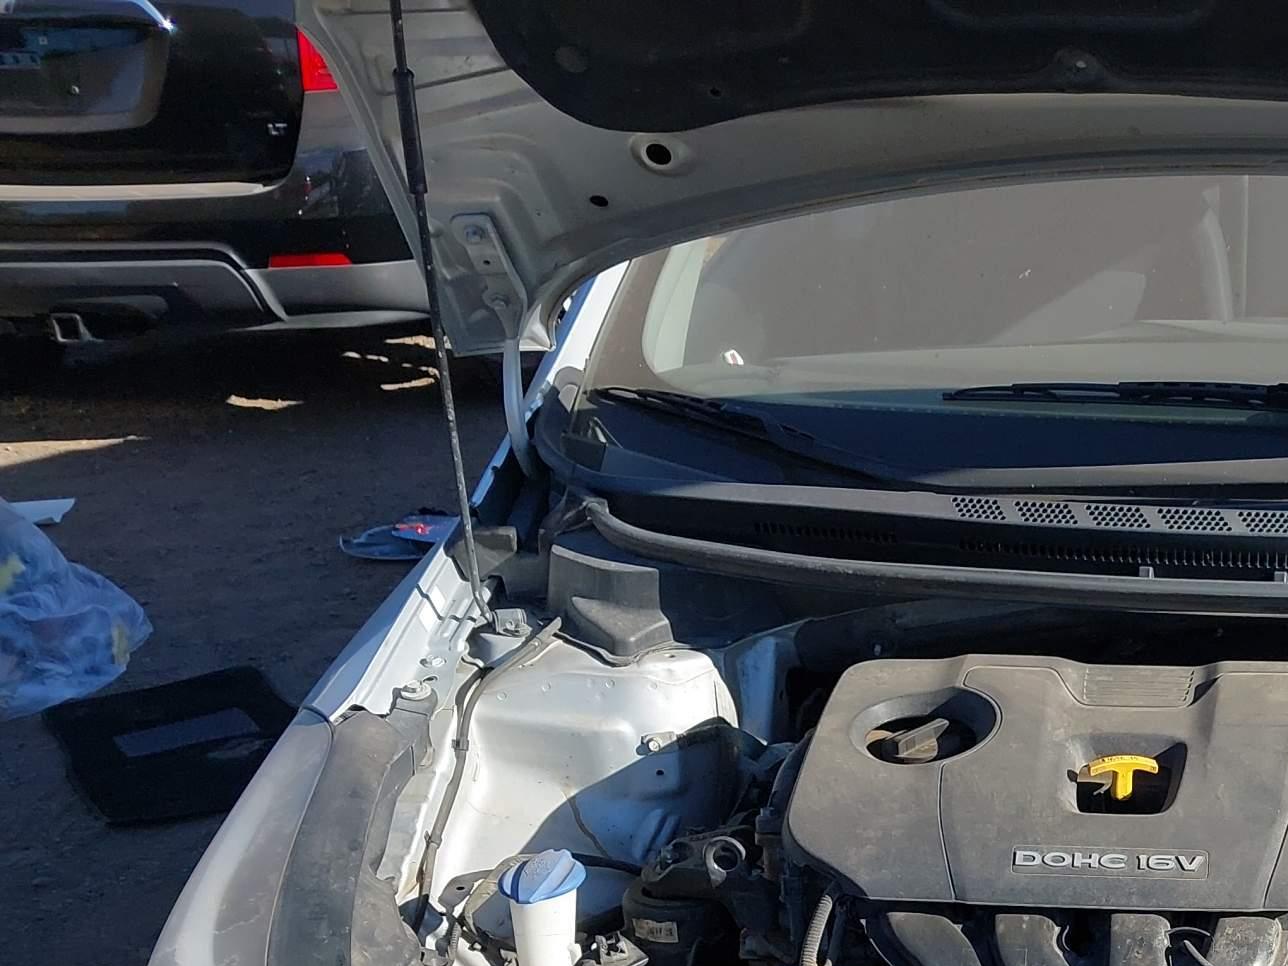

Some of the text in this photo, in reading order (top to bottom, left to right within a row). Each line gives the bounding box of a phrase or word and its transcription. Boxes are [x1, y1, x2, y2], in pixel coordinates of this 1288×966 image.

[266, 122, 288, 136] LT
[1014, 850, 1204, 872] DOHC 16V
